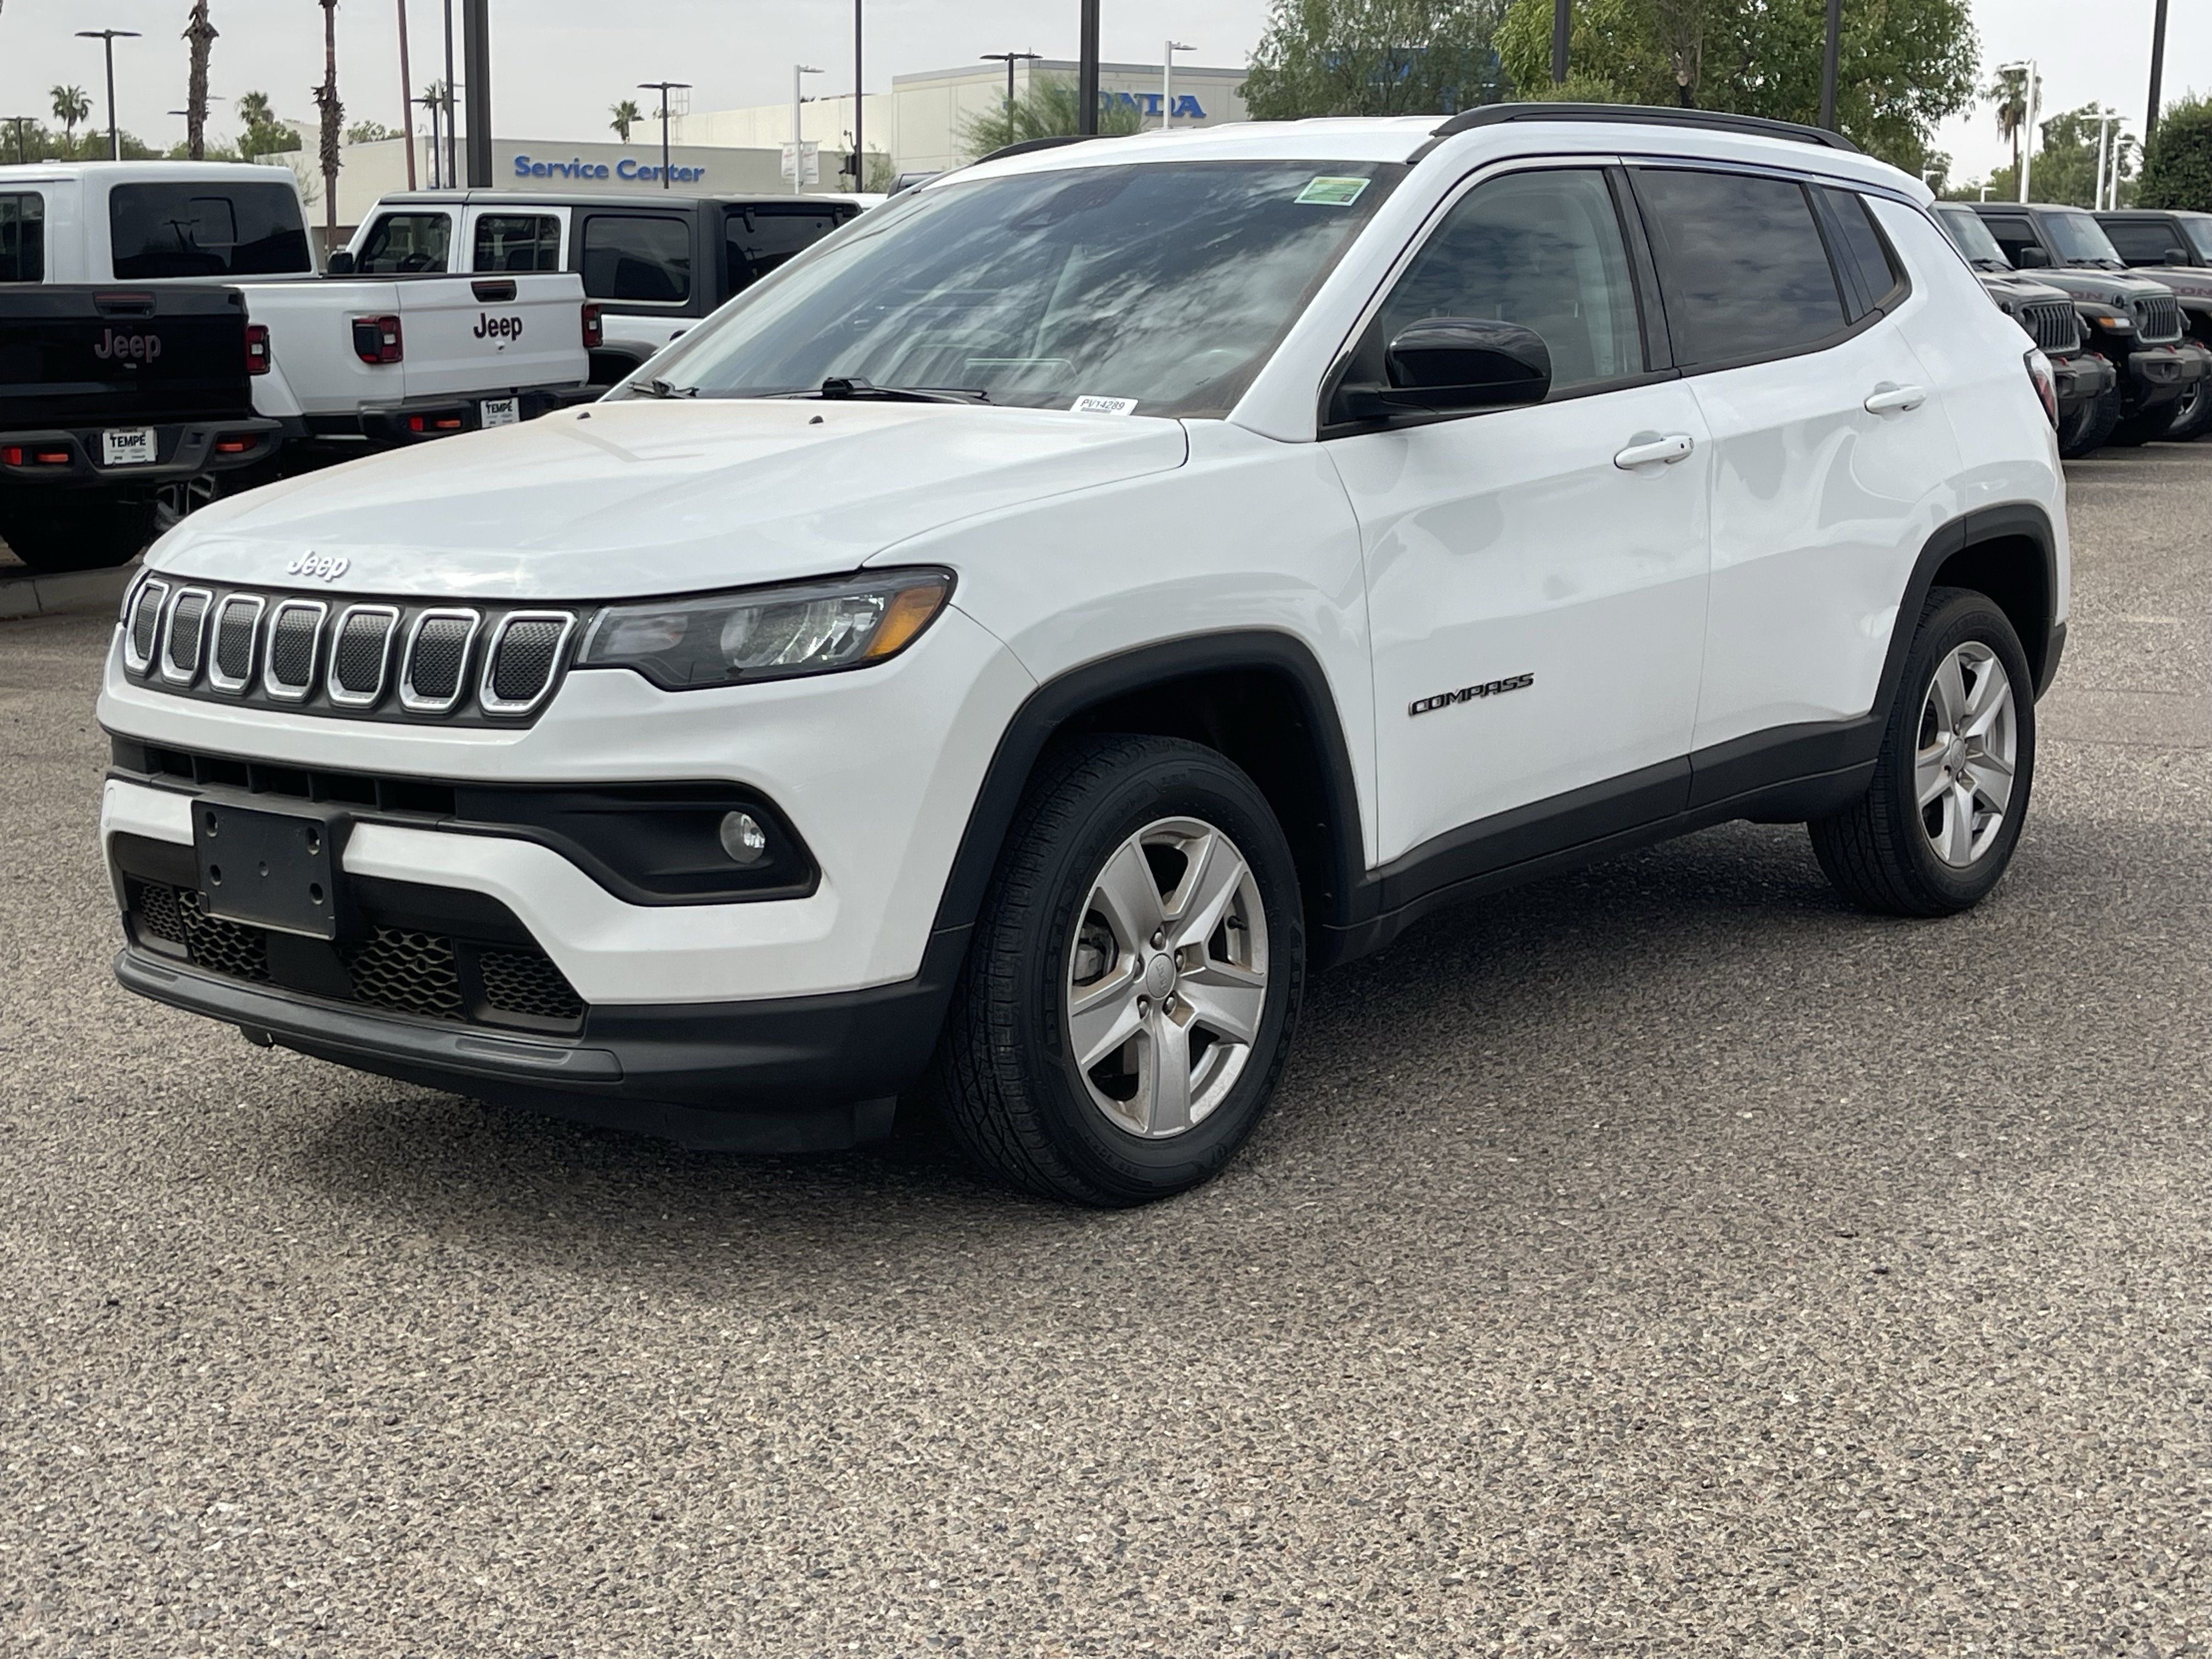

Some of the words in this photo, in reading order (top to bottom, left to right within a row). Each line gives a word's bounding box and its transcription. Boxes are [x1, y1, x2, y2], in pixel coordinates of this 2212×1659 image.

[514, 155, 609, 179] Service
[616, 159, 705, 182] Center
[473, 313, 522, 340] Jeep
[94, 329, 161, 363] Jeep
[1080, 398, 1125, 410] PV14289
[110, 434, 146, 448] TEMPE
[286, 549, 351, 582] Jeep
[1408, 672, 1534, 717] COMPASS
